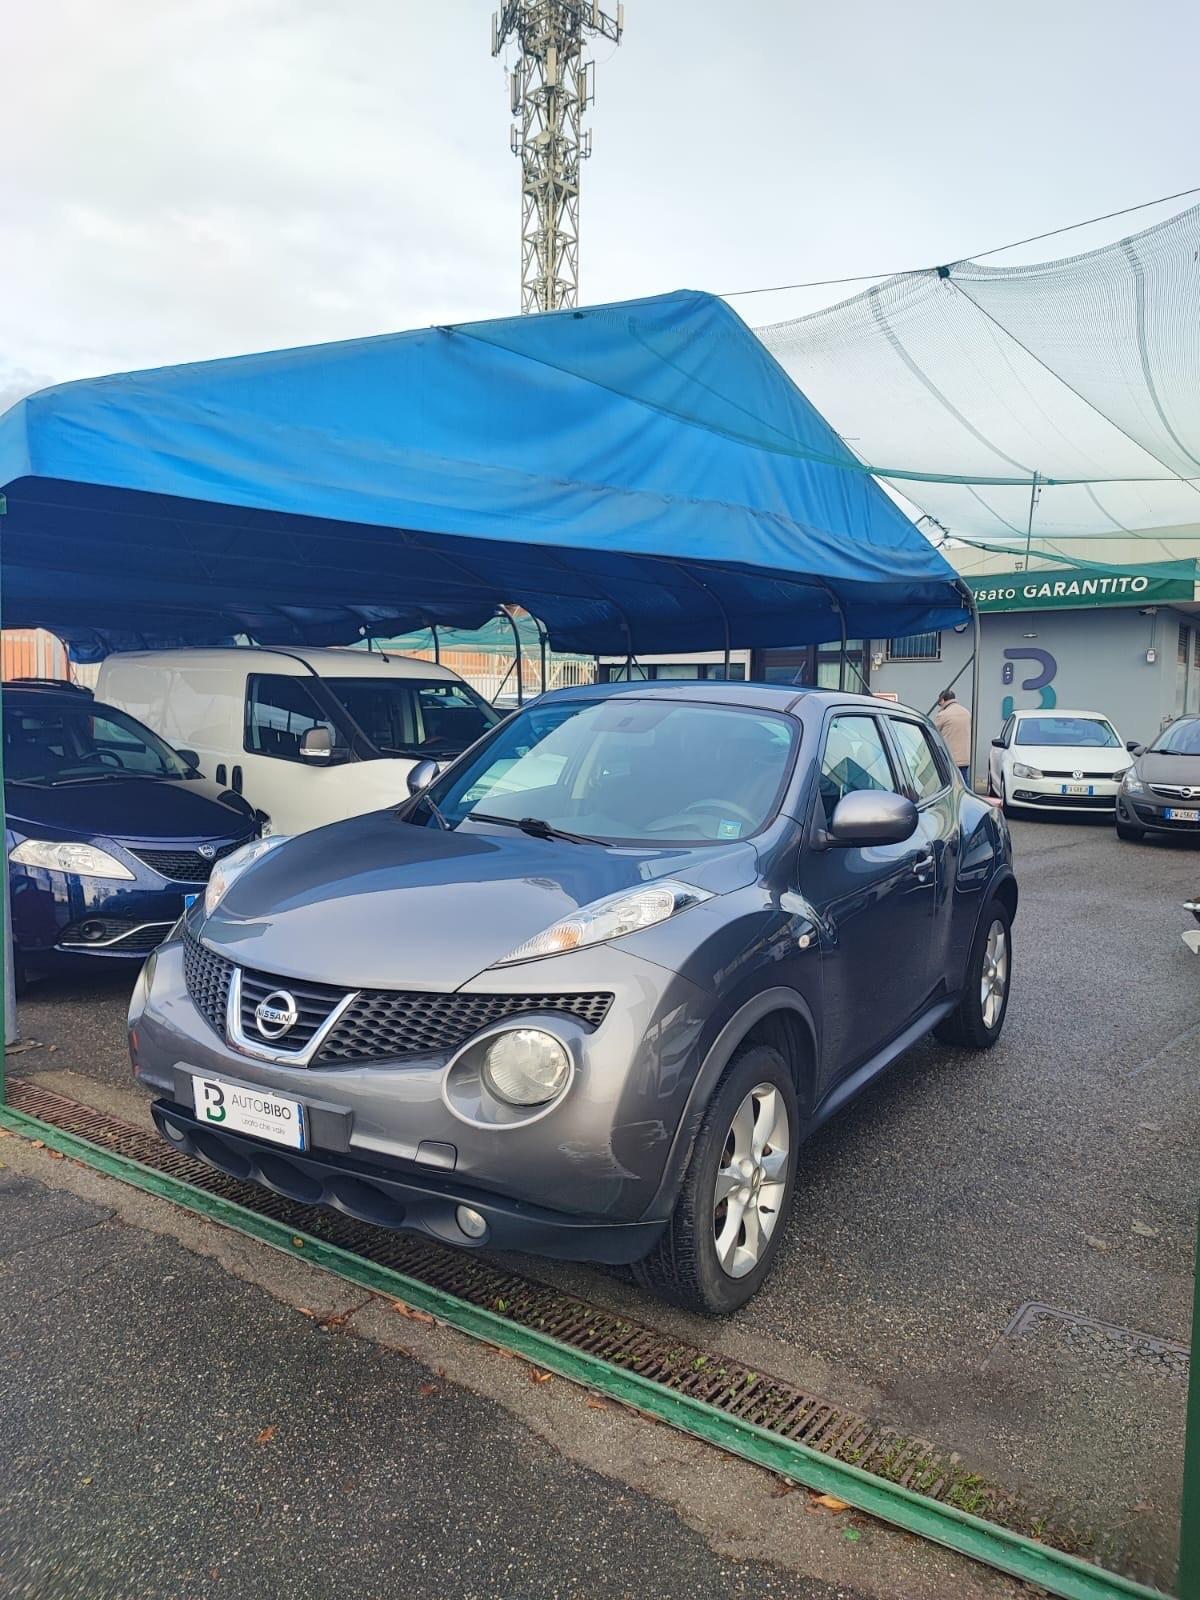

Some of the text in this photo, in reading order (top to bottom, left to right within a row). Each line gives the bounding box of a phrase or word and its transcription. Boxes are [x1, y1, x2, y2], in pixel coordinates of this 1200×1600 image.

[1023, 576, 1149, 598] GARANTITO
[257, 1008, 290, 1022] NISSAN
[231, 1094, 292, 1120] AUTOBIBO
